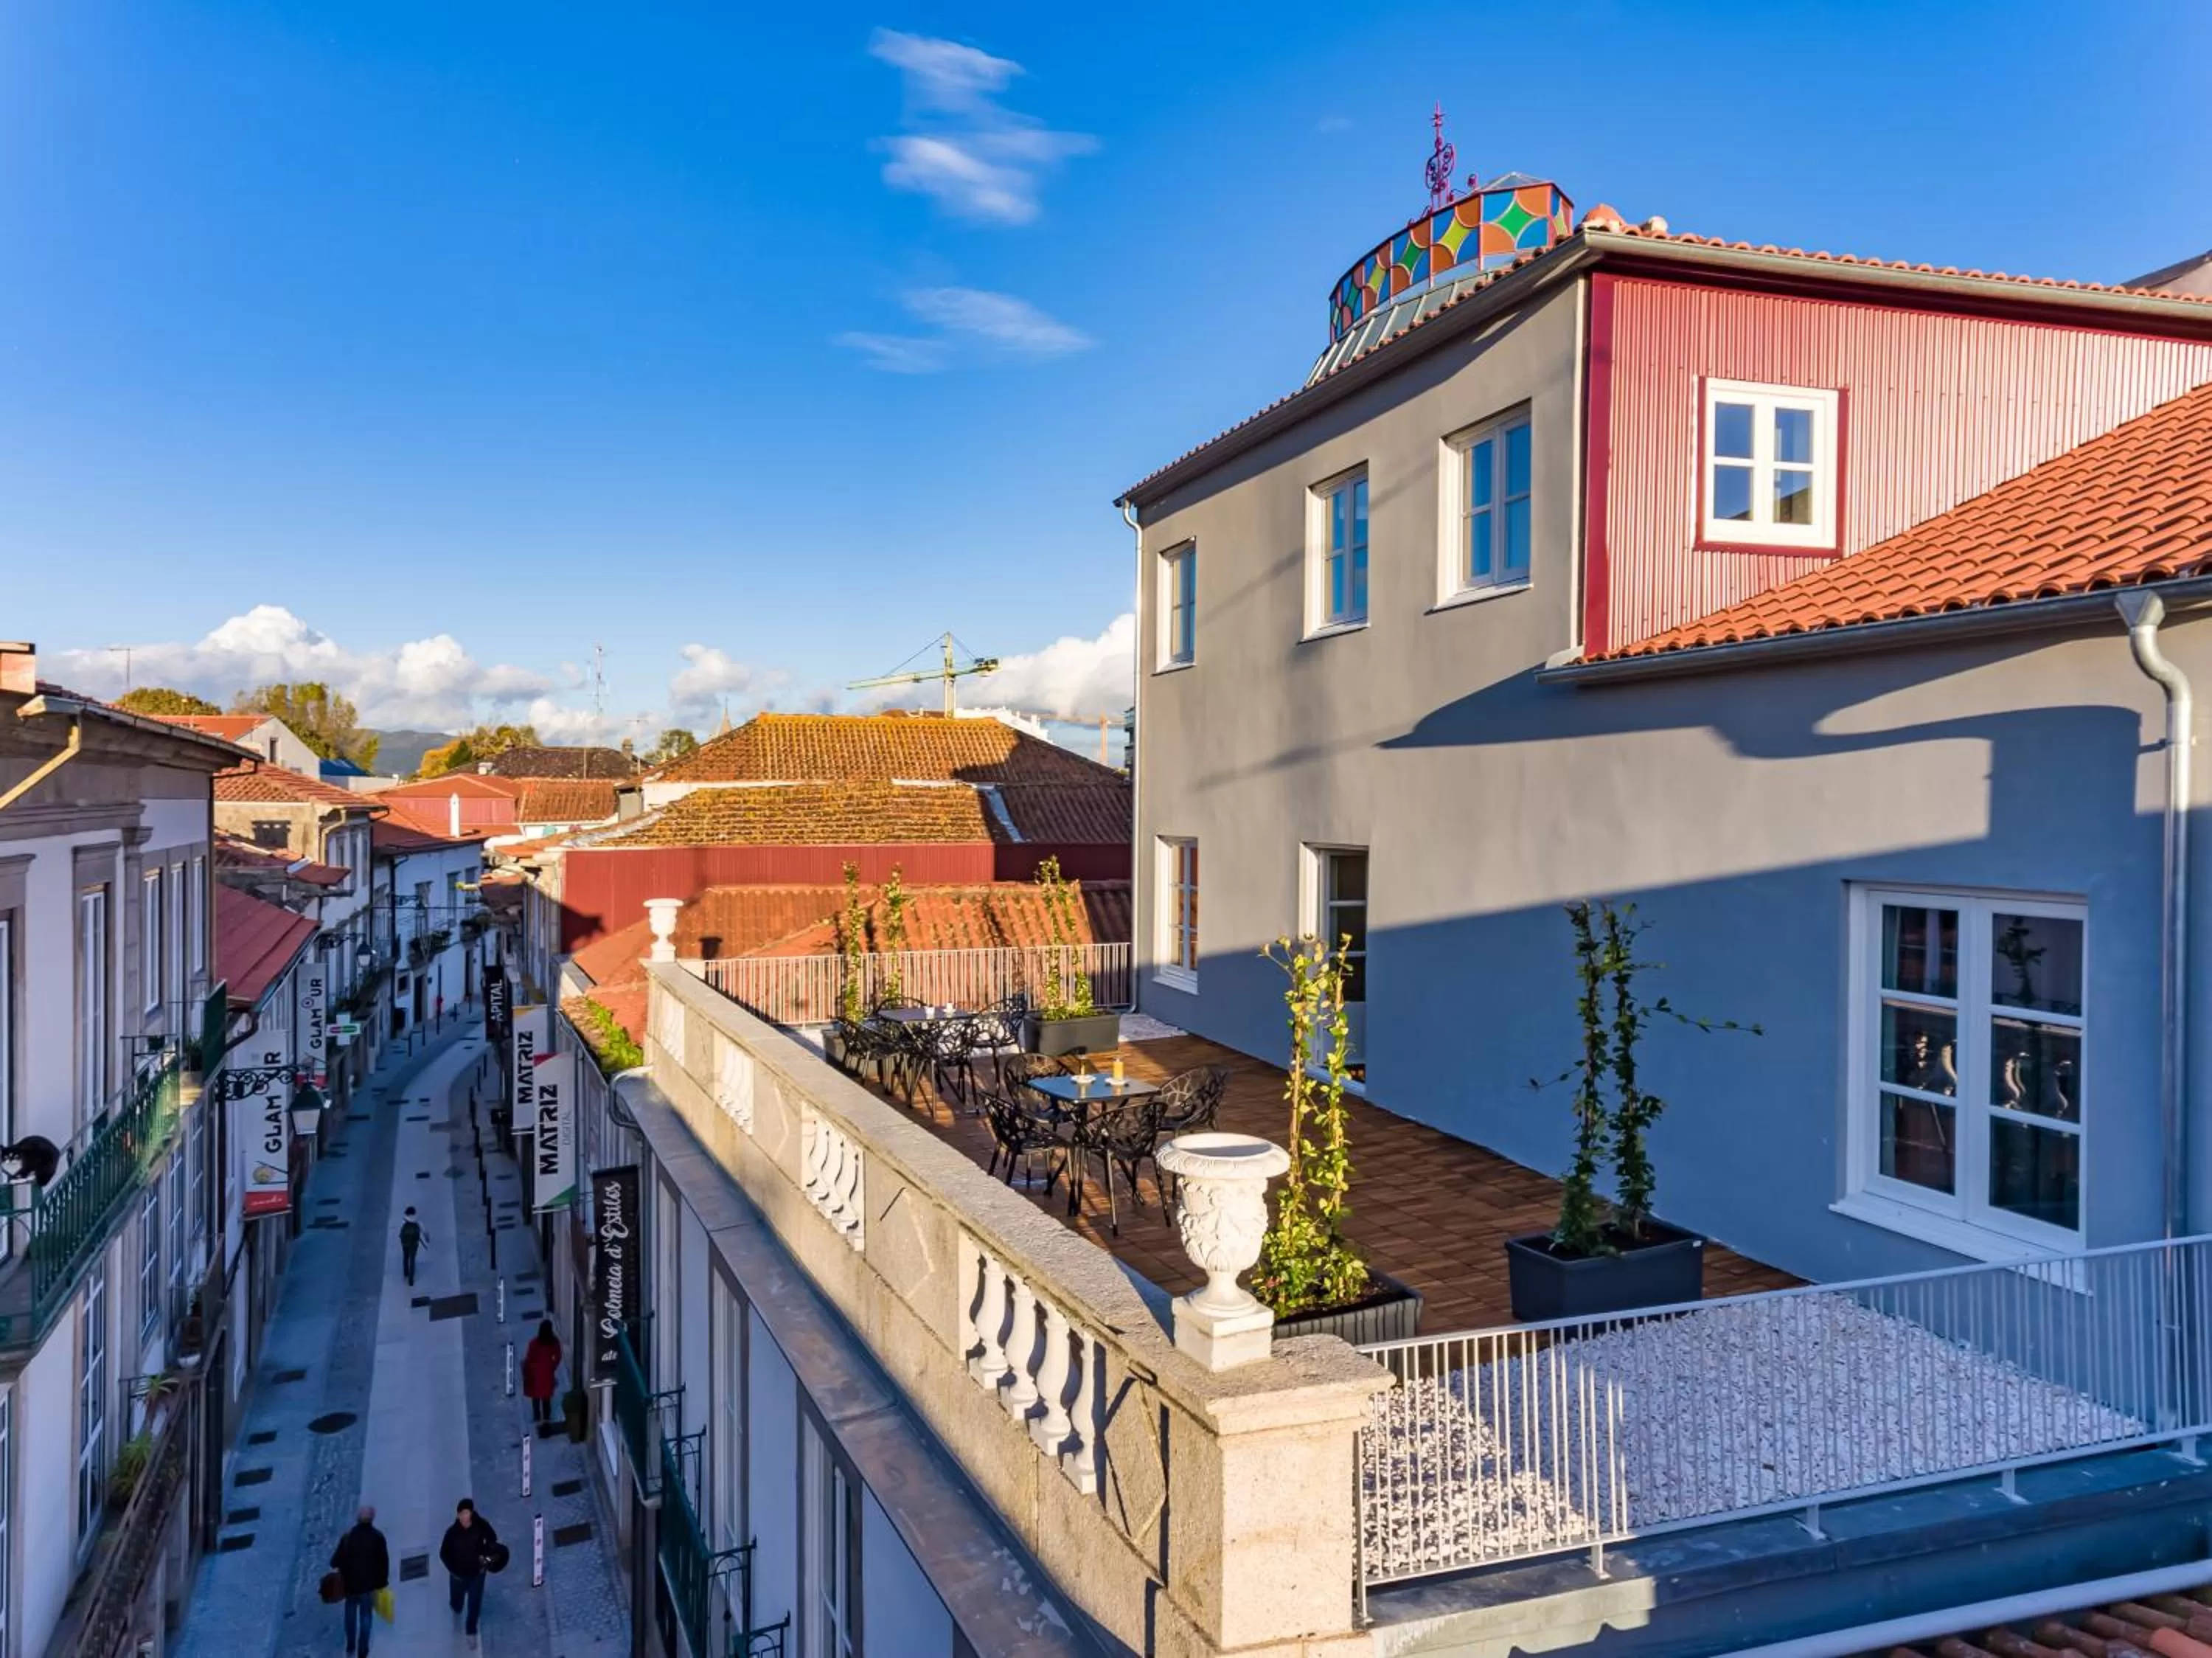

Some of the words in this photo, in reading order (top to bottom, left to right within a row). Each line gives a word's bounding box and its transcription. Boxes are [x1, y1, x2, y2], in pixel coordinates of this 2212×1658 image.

[490, 979, 503, 1022] APITAL
[518, 1031, 533, 1104] MATRIZ
[539, 1084, 558, 1176] MATRIZ
